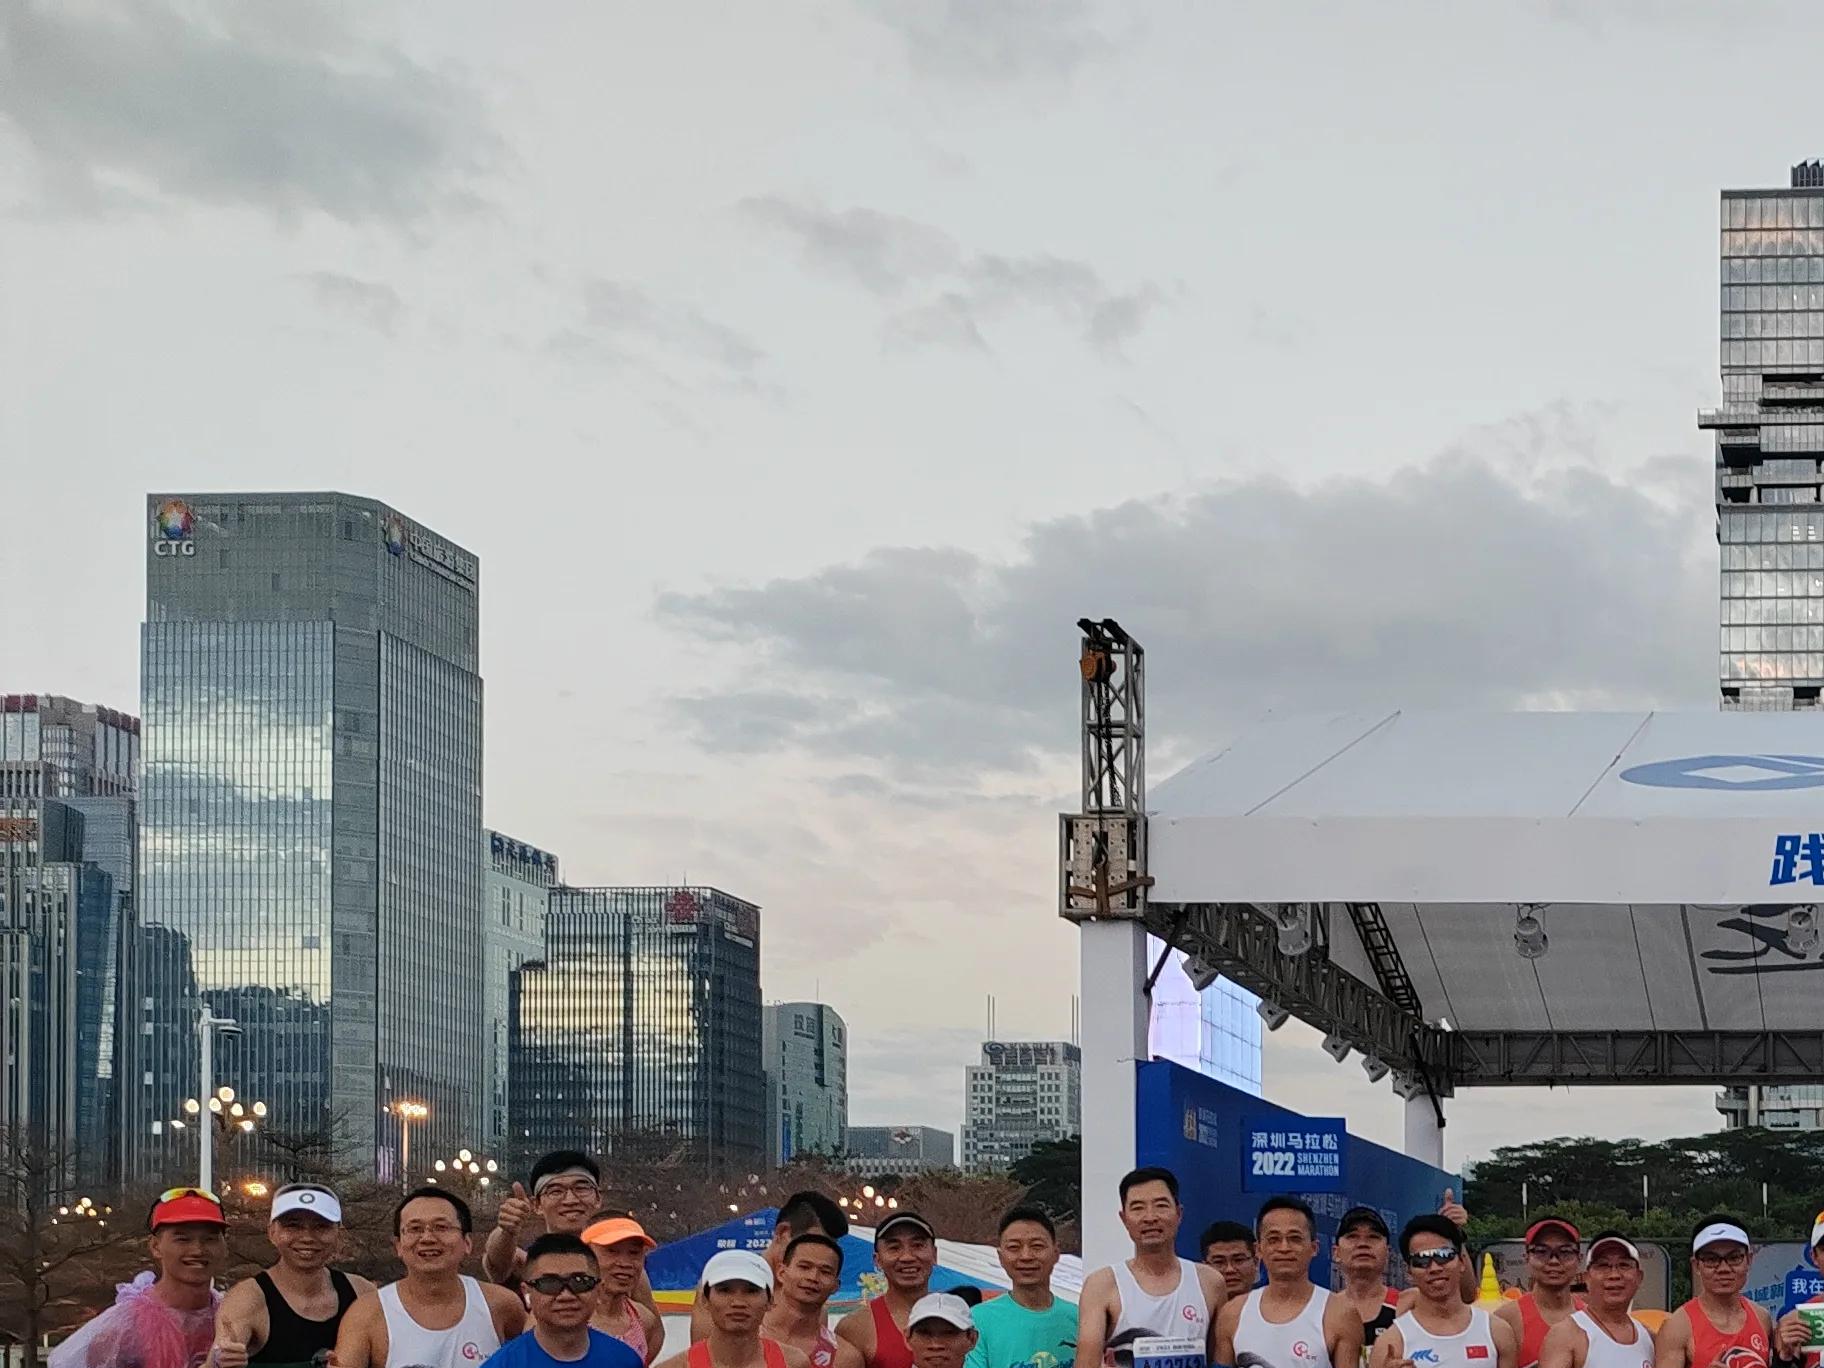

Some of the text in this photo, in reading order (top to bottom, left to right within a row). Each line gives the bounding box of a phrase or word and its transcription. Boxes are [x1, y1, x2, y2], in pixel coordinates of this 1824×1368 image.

[154, 540, 196, 556] CTG
[1252, 1131, 1339, 1150] 深圳马拉松
[1252, 1151, 1340, 1176] 2022 SHENZHEN
[1297, 1164, 1340, 1177] MARATHON
